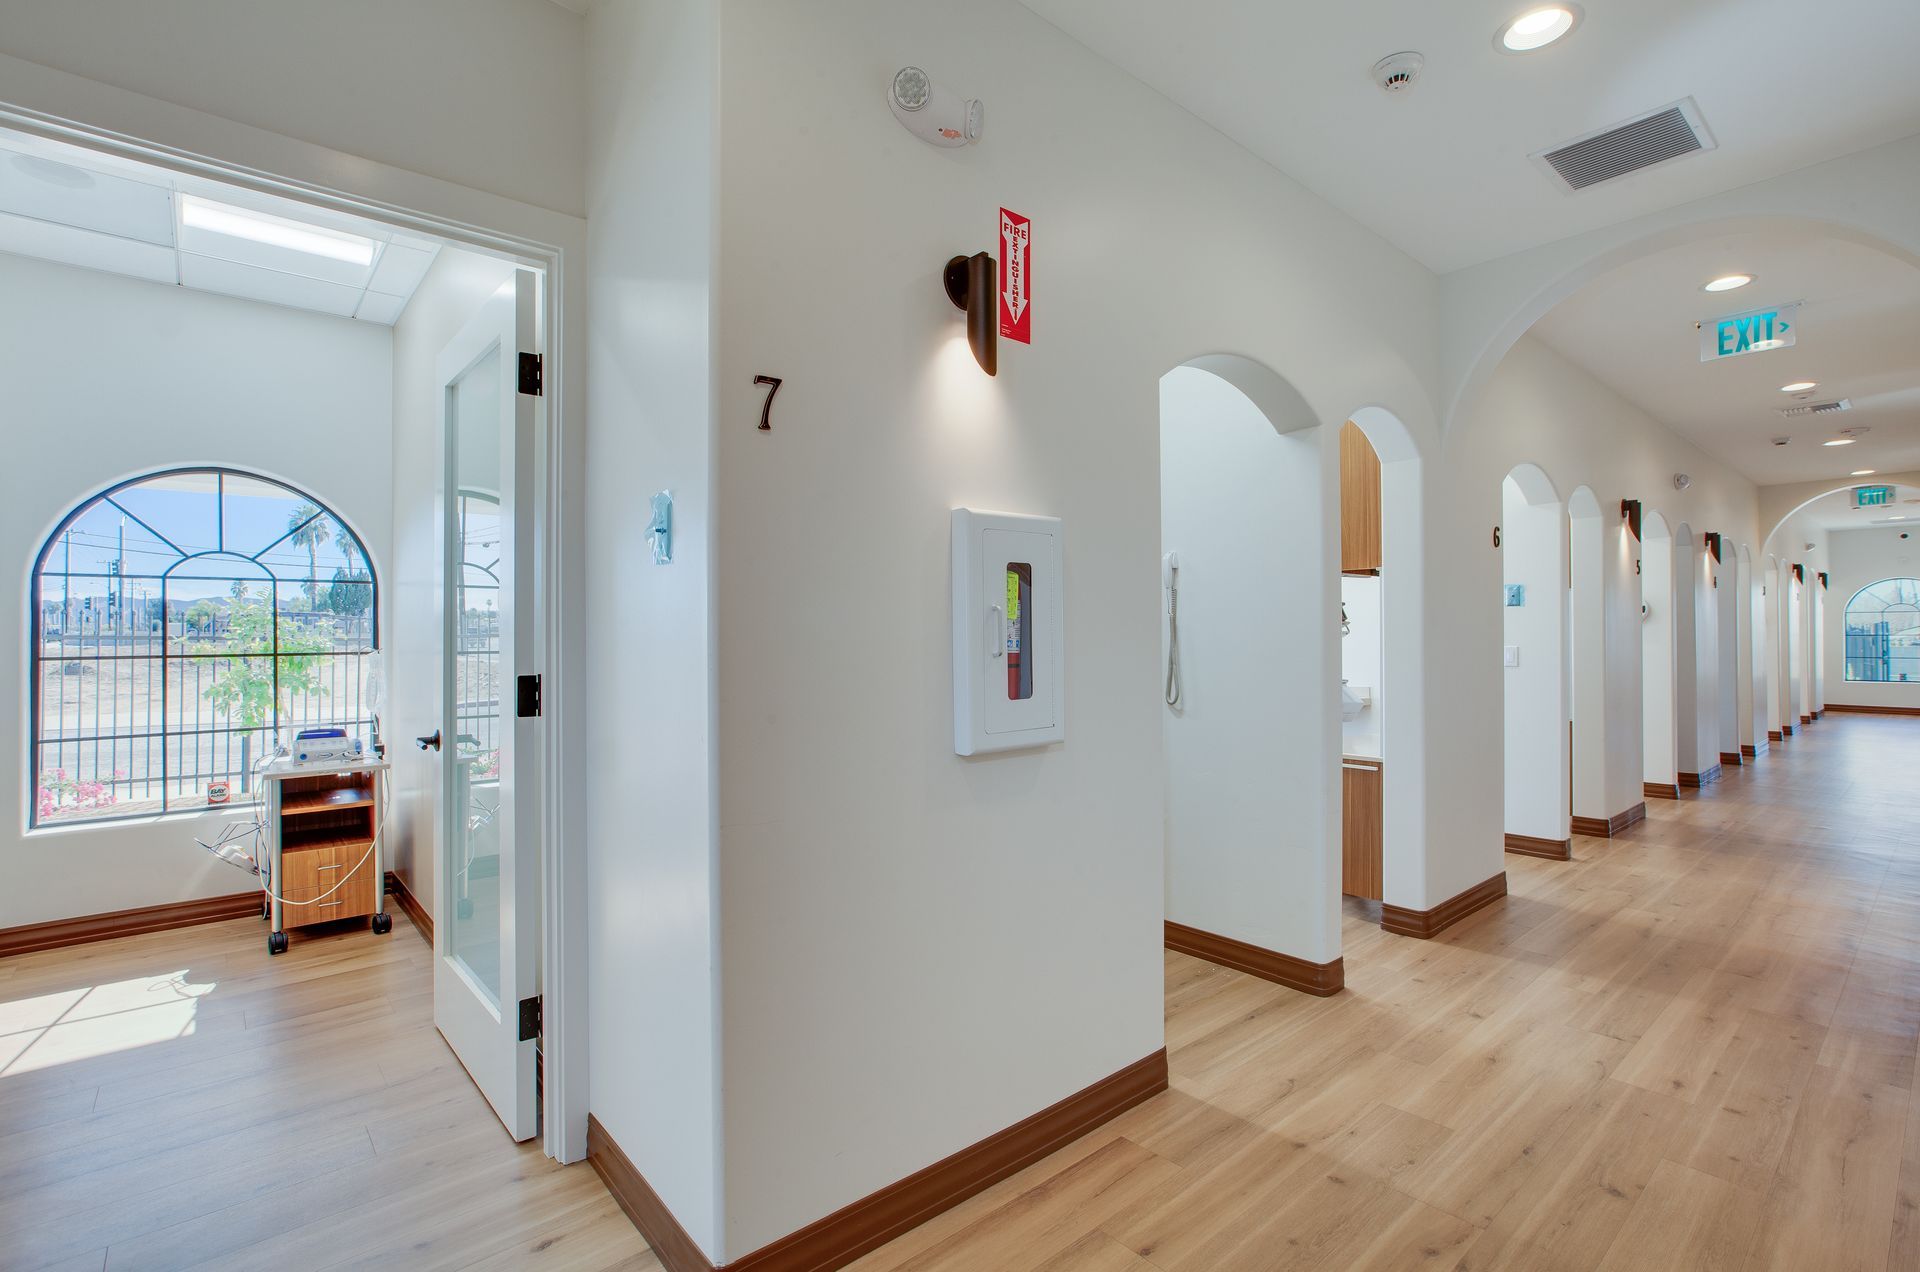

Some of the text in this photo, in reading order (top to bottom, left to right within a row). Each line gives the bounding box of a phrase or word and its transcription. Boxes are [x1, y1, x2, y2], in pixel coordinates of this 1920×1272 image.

[1003, 222, 1027, 240] FIRE
[1718, 312, 1777, 356] EXIT
[753, 375, 783, 431] 7
[1857, 488, 1888, 505] EXIT
[1493, 526, 1500, 548] 6
[1636, 559, 1641, 575] 5
